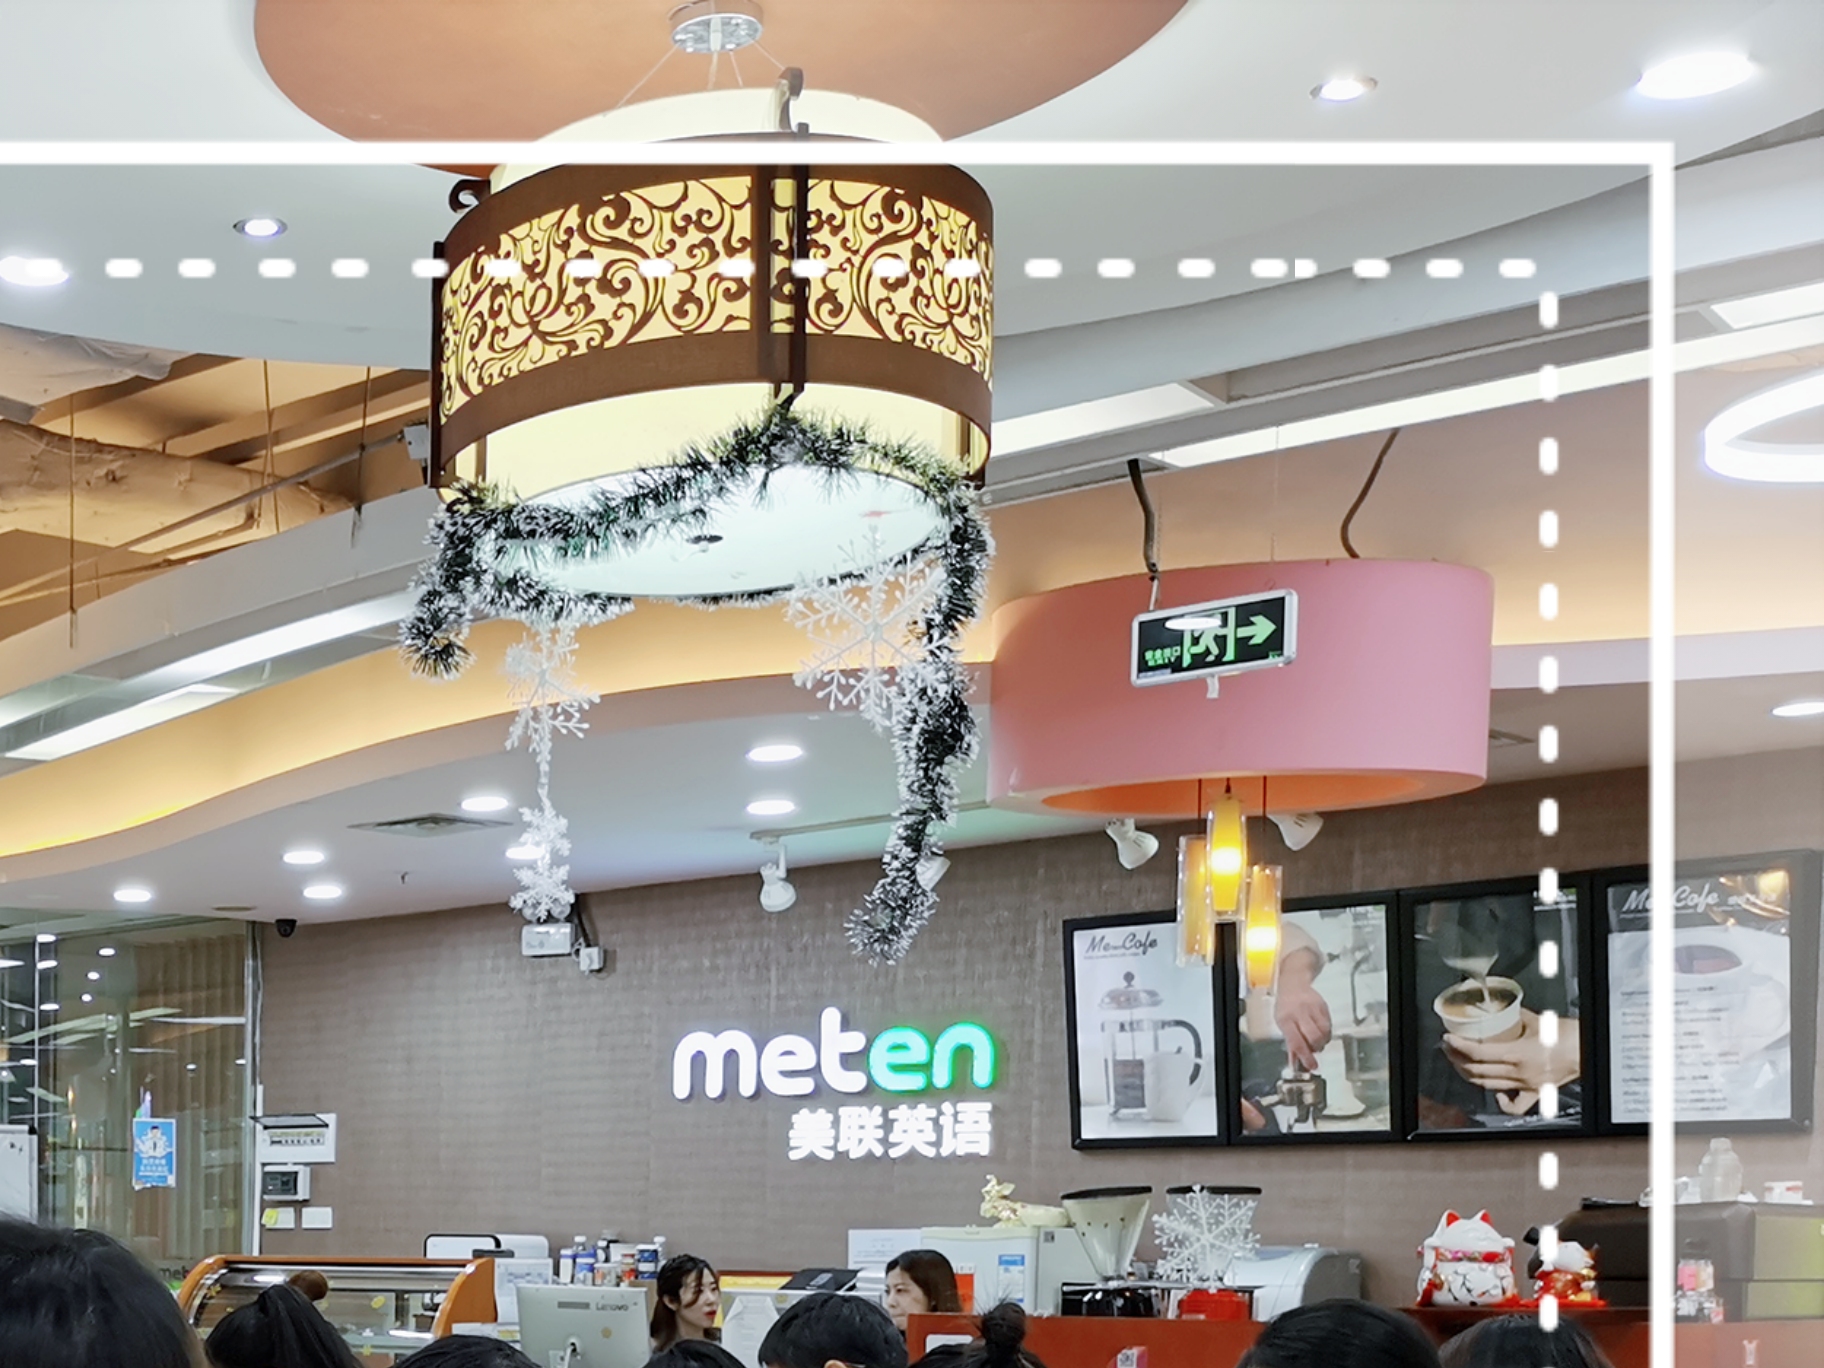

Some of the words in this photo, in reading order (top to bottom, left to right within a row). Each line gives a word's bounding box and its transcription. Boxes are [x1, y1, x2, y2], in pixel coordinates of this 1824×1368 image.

[672, 1006, 994, 1100] meten
[788, 1101, 993, 1161] 美联英语
